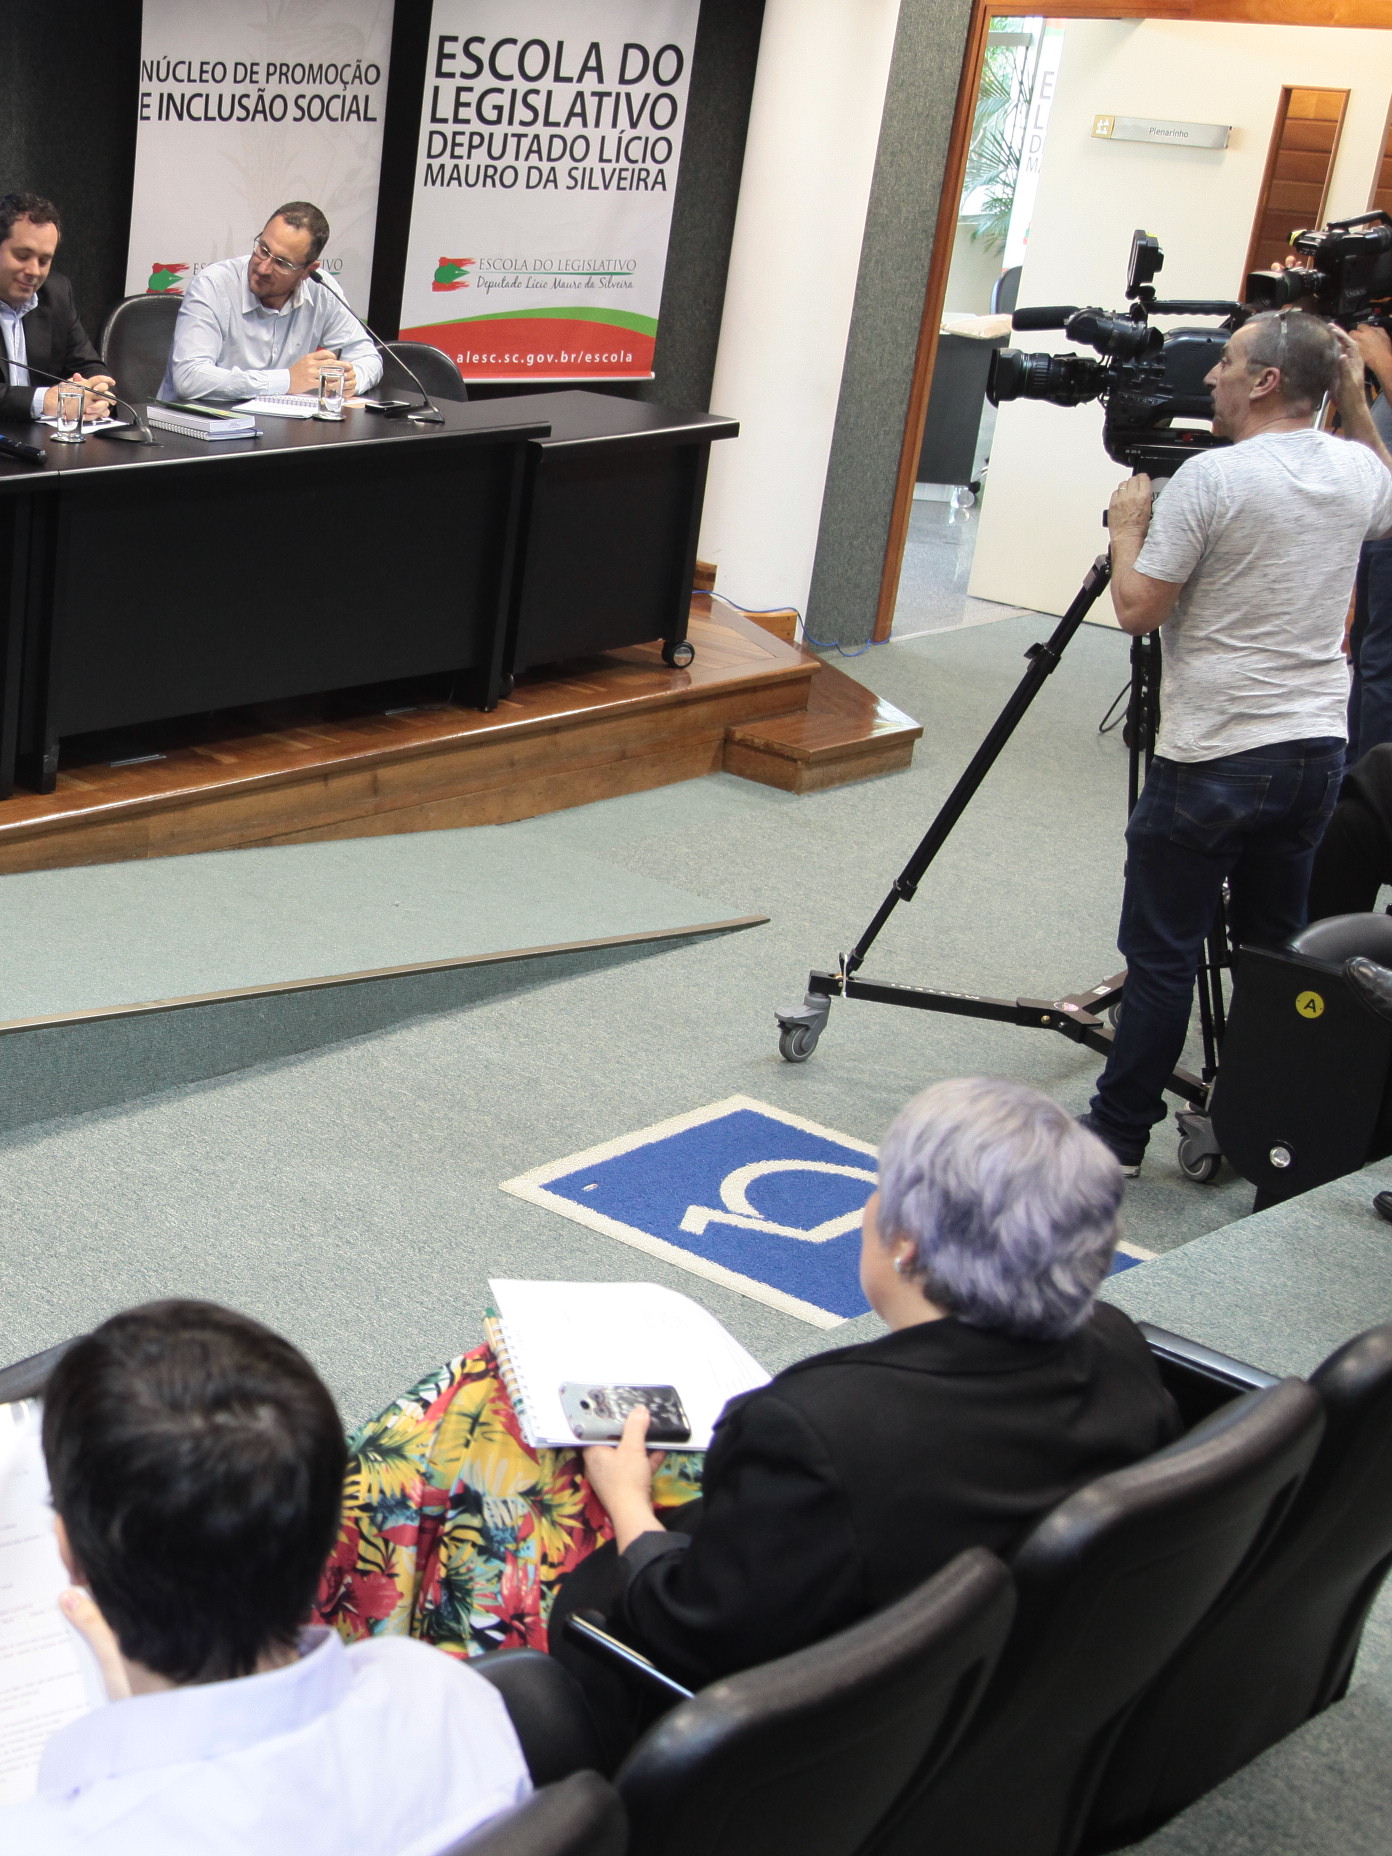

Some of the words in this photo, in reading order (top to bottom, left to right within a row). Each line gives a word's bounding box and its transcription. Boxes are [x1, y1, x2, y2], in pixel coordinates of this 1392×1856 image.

[141, 55, 227, 84] NÚCLEO
[233, 61, 260, 85] DE
[265, 59, 381, 91] PROMOÇÃO
[434, 35, 605, 85] ESCOLA
[617, 42, 685, 87] DO
[139, 92, 152, 122] E
[157, 88, 289, 122] INCLUSÃO
[292, 94, 378, 123] SOCIAL
[429, 85, 678, 131] LEGISLATIVO
[426, 130, 591, 164] DEPUTADO
[598, 129, 673, 165] LÍCIO
[1148, 126, 1189, 139] Plenarinho
[423, 163, 519, 189] MAURO
[525, 165, 558, 190] DA
[565, 166, 667, 192] SILVEIRA
[479, 257, 528, 271] ESCOLA
[533, 258, 554, 272] DO
[557, 258, 637, 272] LEGISLATIVO
[476, 275, 523, 295] Deputado
[550, 277, 582, 290] Mauro
[584, 275, 596, 290] da
[597, 274, 635, 290] Silveira
[1303, 998, 1317, 1014] A
